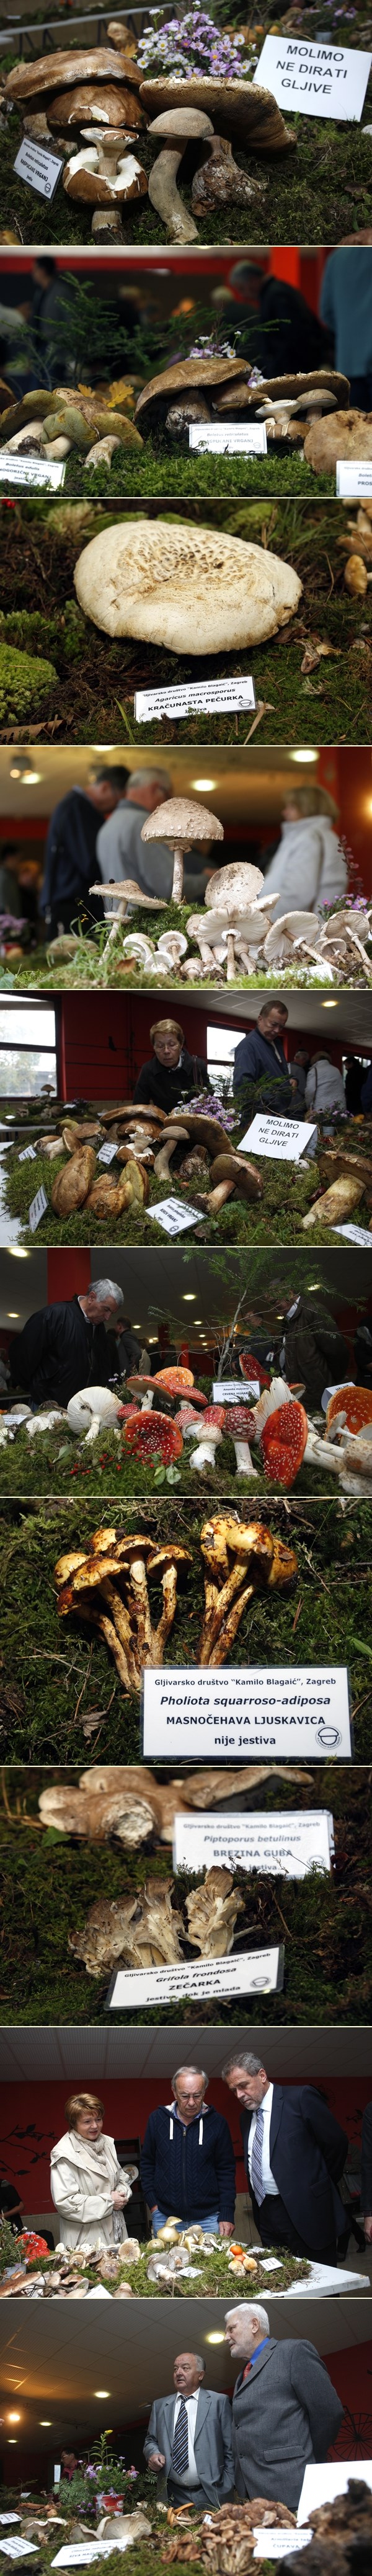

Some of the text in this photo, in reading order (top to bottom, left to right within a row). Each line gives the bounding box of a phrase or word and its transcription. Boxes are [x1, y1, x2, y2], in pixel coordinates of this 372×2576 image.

[286, 45, 344, 61] MOLIMO
[277, 61, 347, 78] NE DIRATI
[281, 78, 332, 94] GLJIVE
[25, 152, 48, 170] Boletus reticulatus
[20, 159, 48, 182] RASPUCANI VRGANJ
[155, 688, 236, 702] Agaricus macrosporus
[148, 695, 243, 711] KRAČUNASTA PEČURKA
[267, 1119, 299, 1129] MOLIMO
[271, 1130, 299, 1138] DIRATI
[259, 1137, 288, 1146] GLJIVE
[155, 1679, 195, 1687] Gljivarsko
[267, 1678, 303, 1686] Blagaić”,
[161, 1696, 331, 1707] Pholiota squarroso-adiposa
[166, 1714, 326, 1725] MASNOČEHAVA LJUSKAVICA
[215, 1736, 276, 1746] nije jestiva
[156, 1968, 237, 1983] Grifola frondosa
[169, 1980, 221, 1991] ZEČARKA
